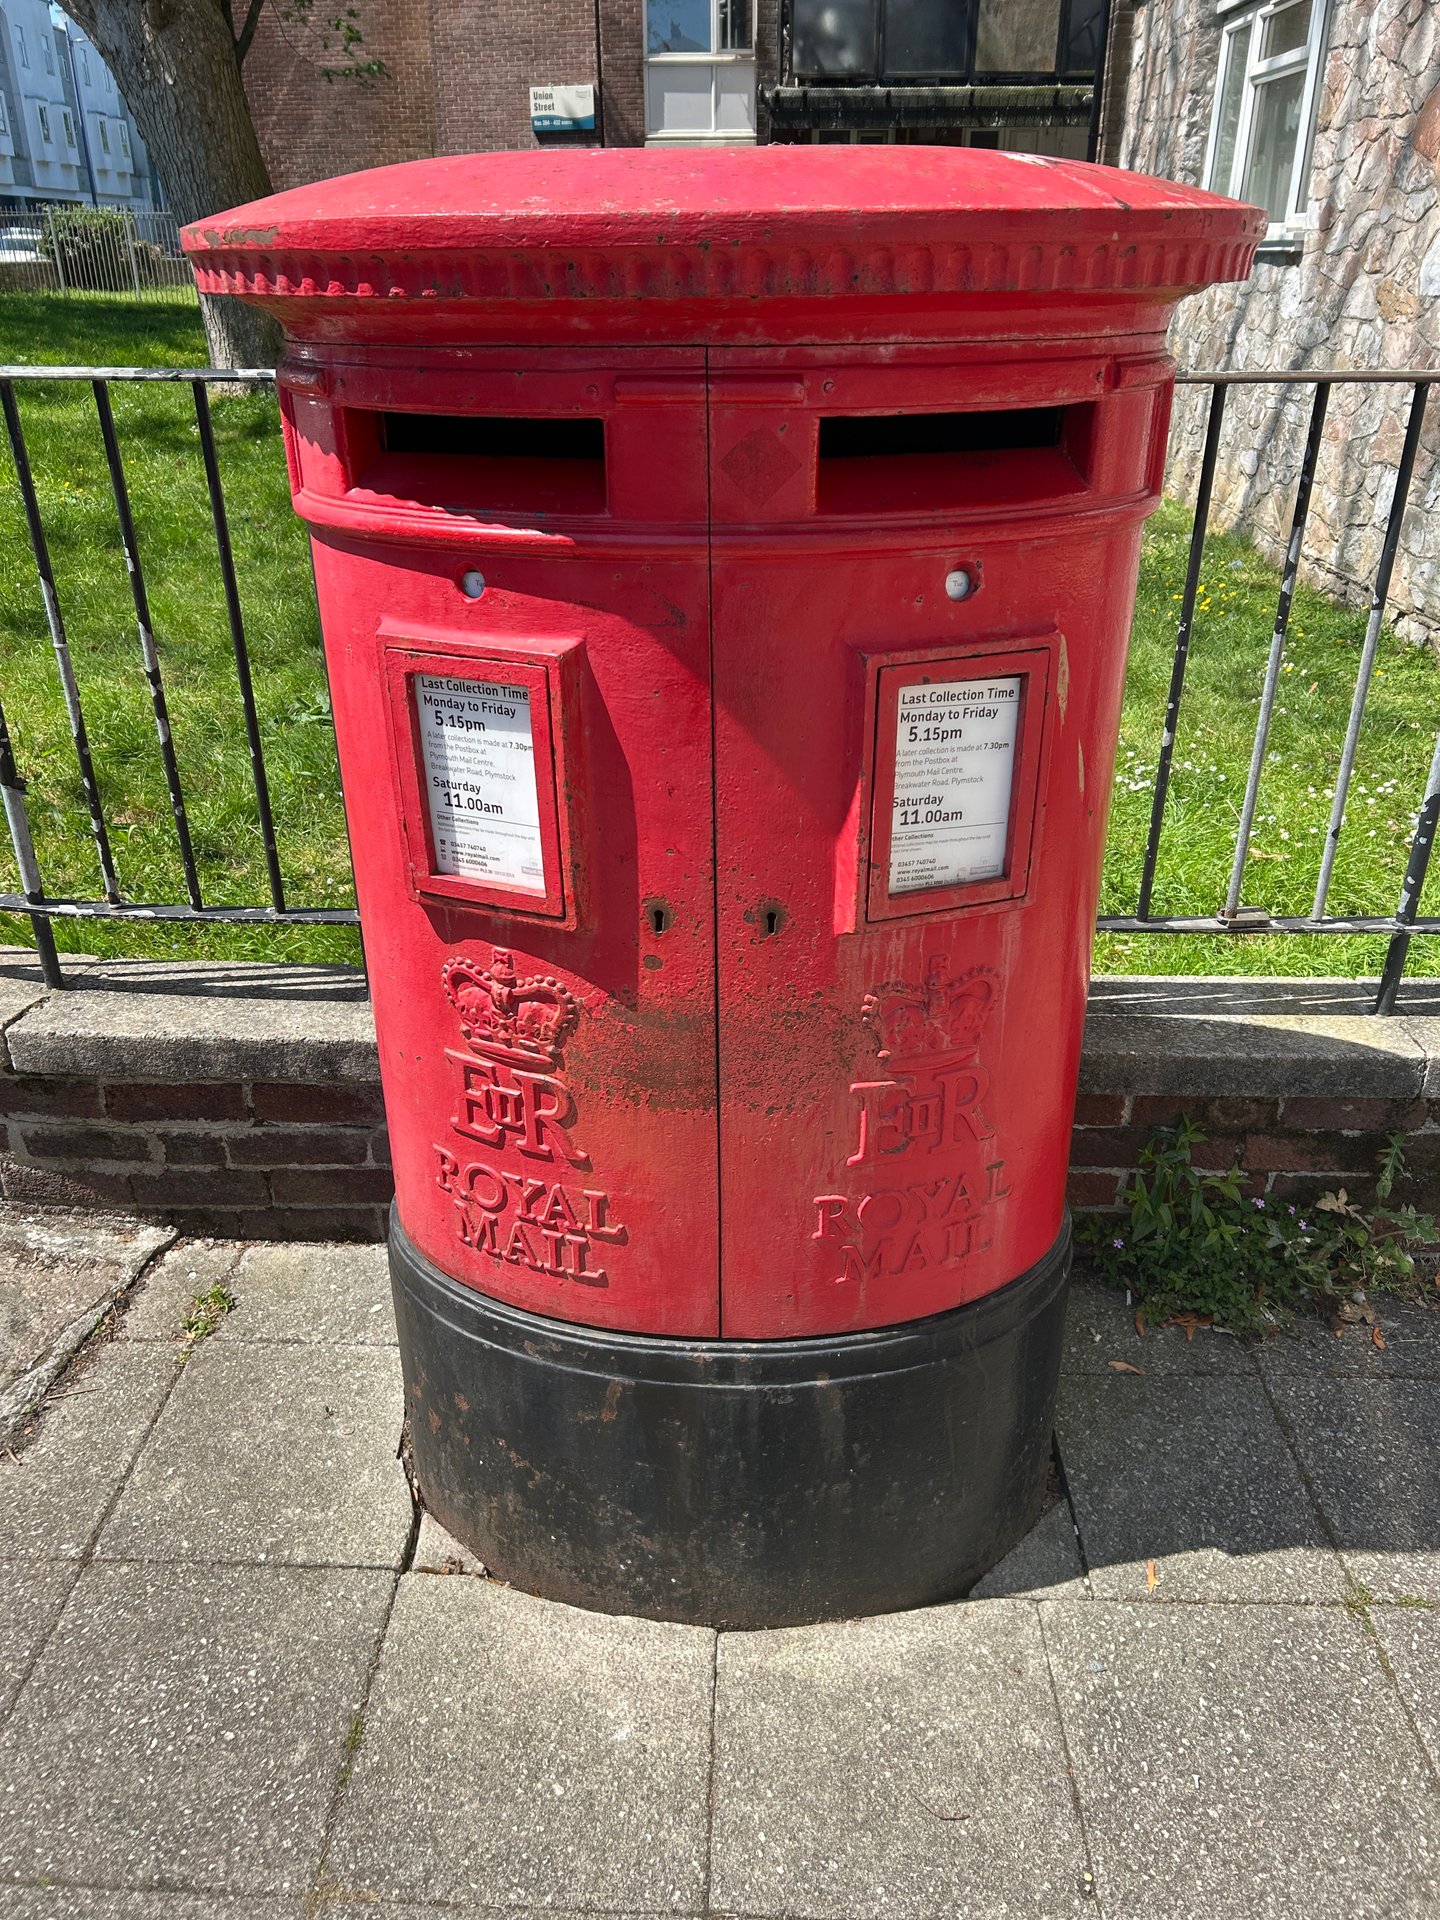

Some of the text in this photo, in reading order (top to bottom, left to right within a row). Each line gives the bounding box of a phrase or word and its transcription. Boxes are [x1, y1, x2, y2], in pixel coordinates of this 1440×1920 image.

[533, 91, 553, 100] Union
[534, 102, 554, 111] Street
[422, 677, 528, 700] Last Collection Time
[902, 688, 1014, 704] Last Collection Time
[423, 695, 516, 718] Monday to Friday
[435, 710, 486, 732] 5.15pm
[900, 708, 998, 724] Monday to Friday
[448, 734, 476, 744] collection
[483, 739, 500, 748] made
[908, 726, 962, 743] 5.15pm
[428, 741, 444, 749] from
[444, 743, 454, 751] the
[454, 744, 479, 754] Postbox
[918, 746, 949, 756] collection
[956, 744, 974, 752] made
[984, 742, 1010, 751] 7.30pm
[430, 752, 458, 763] Plymouth
[460, 756, 472, 764] Mail
[431, 762, 465, 774] Breakwater
[485, 770, 516, 781] Plymstock
[926, 768, 940, 776] Mail
[433, 776, 481, 794] Saturday
[952, 776, 984, 786] Plymstock
[444, 792, 504, 814] 11.00am
[893, 794, 944, 808] Saturday
[900, 809, 962, 826] 11.00am
[897, 865, 950, 875] www.royalmail.com
[433, 1143, 625, 1244] ROYAL
[811, 1160, 1013, 1239] ROYAL
[454, 1199, 607, 1286] MAIL
[833, 1214, 992, 1284] MAIL
